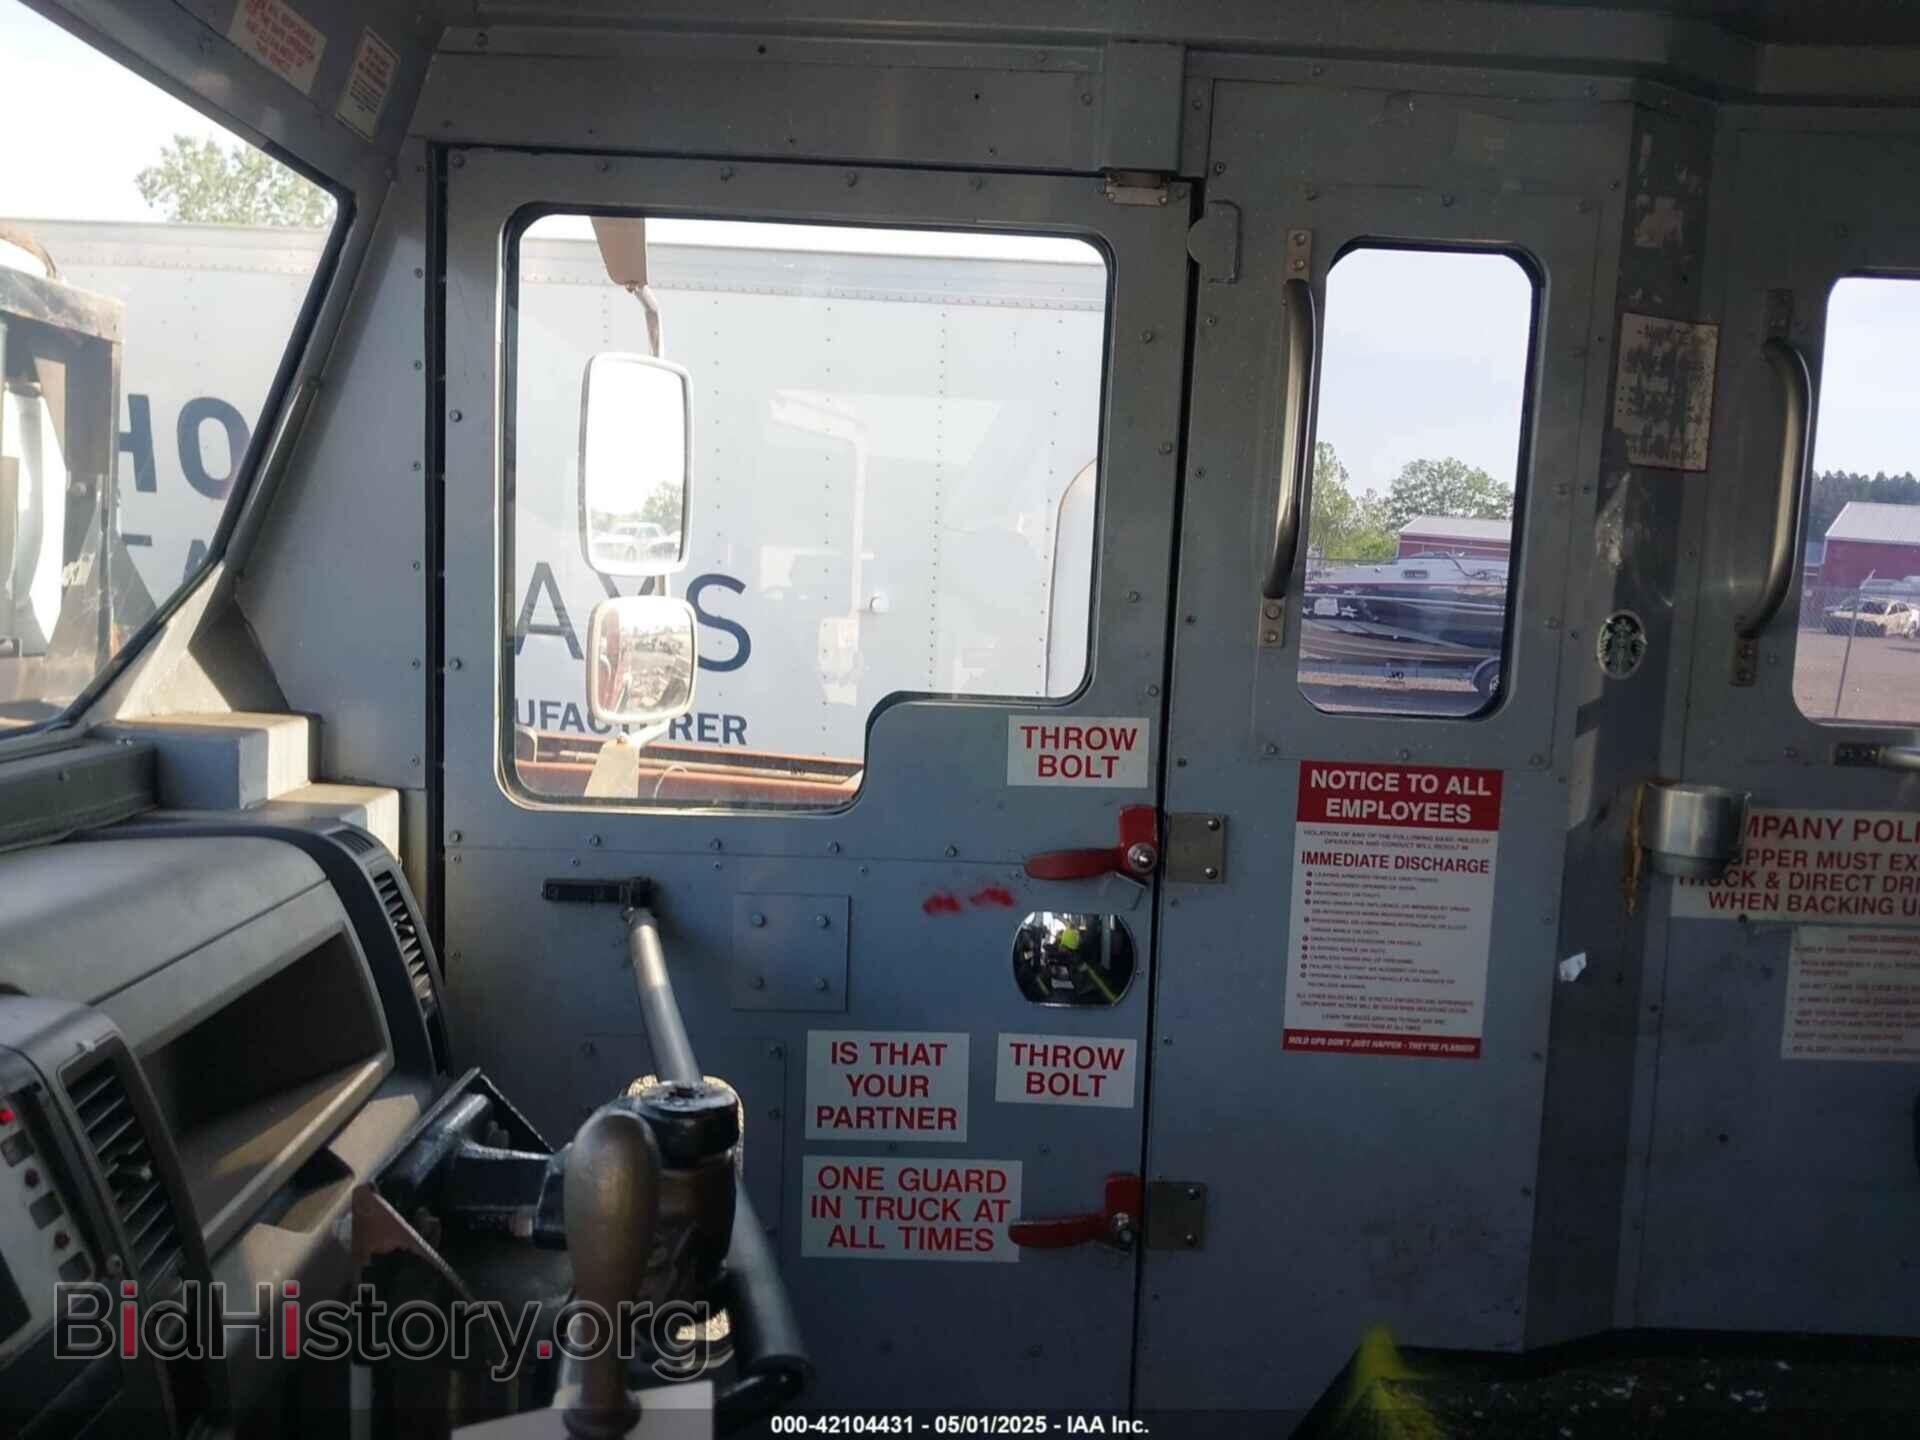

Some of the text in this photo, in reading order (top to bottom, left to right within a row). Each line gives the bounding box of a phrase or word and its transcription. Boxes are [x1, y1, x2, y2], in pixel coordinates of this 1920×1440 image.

[515, 562, 752, 672] AS
[515, 698, 748, 746] UFACRER
[1020, 725, 1137, 752] THROW
[1037, 755, 1121, 779] BOLT
[1310, 769, 1492, 796] NOTICE TO ALL
[1326, 798, 1472, 824] EMPLOYEES
[1301, 850, 1490, 875] IMMEDIATE DISCHARGE
[1730, 849, 1809, 870] PPER
[1816, 851, 1883, 871] MUST
[1765, 872, 1782, 889] &
[1789, 873, 1876, 893] DIRECT
[1708, 891, 1779, 911] WHEN
[1787, 894, 1893, 915] BACKING
[831, 1041, 948, 1067] IS THAT
[1010, 1043, 1125, 1071] THROW
[846, 1074, 929, 1098] YOUR
[1025, 1072, 1107, 1097] BOLT
[816, 1106, 957, 1131] PARTNER
[817, 1165, 1007, 1193] ONE GUARD
[811, 1196, 1011, 1223] IN TRUCK AT
[827, 1226, 995, 1252] ALL TIMES
